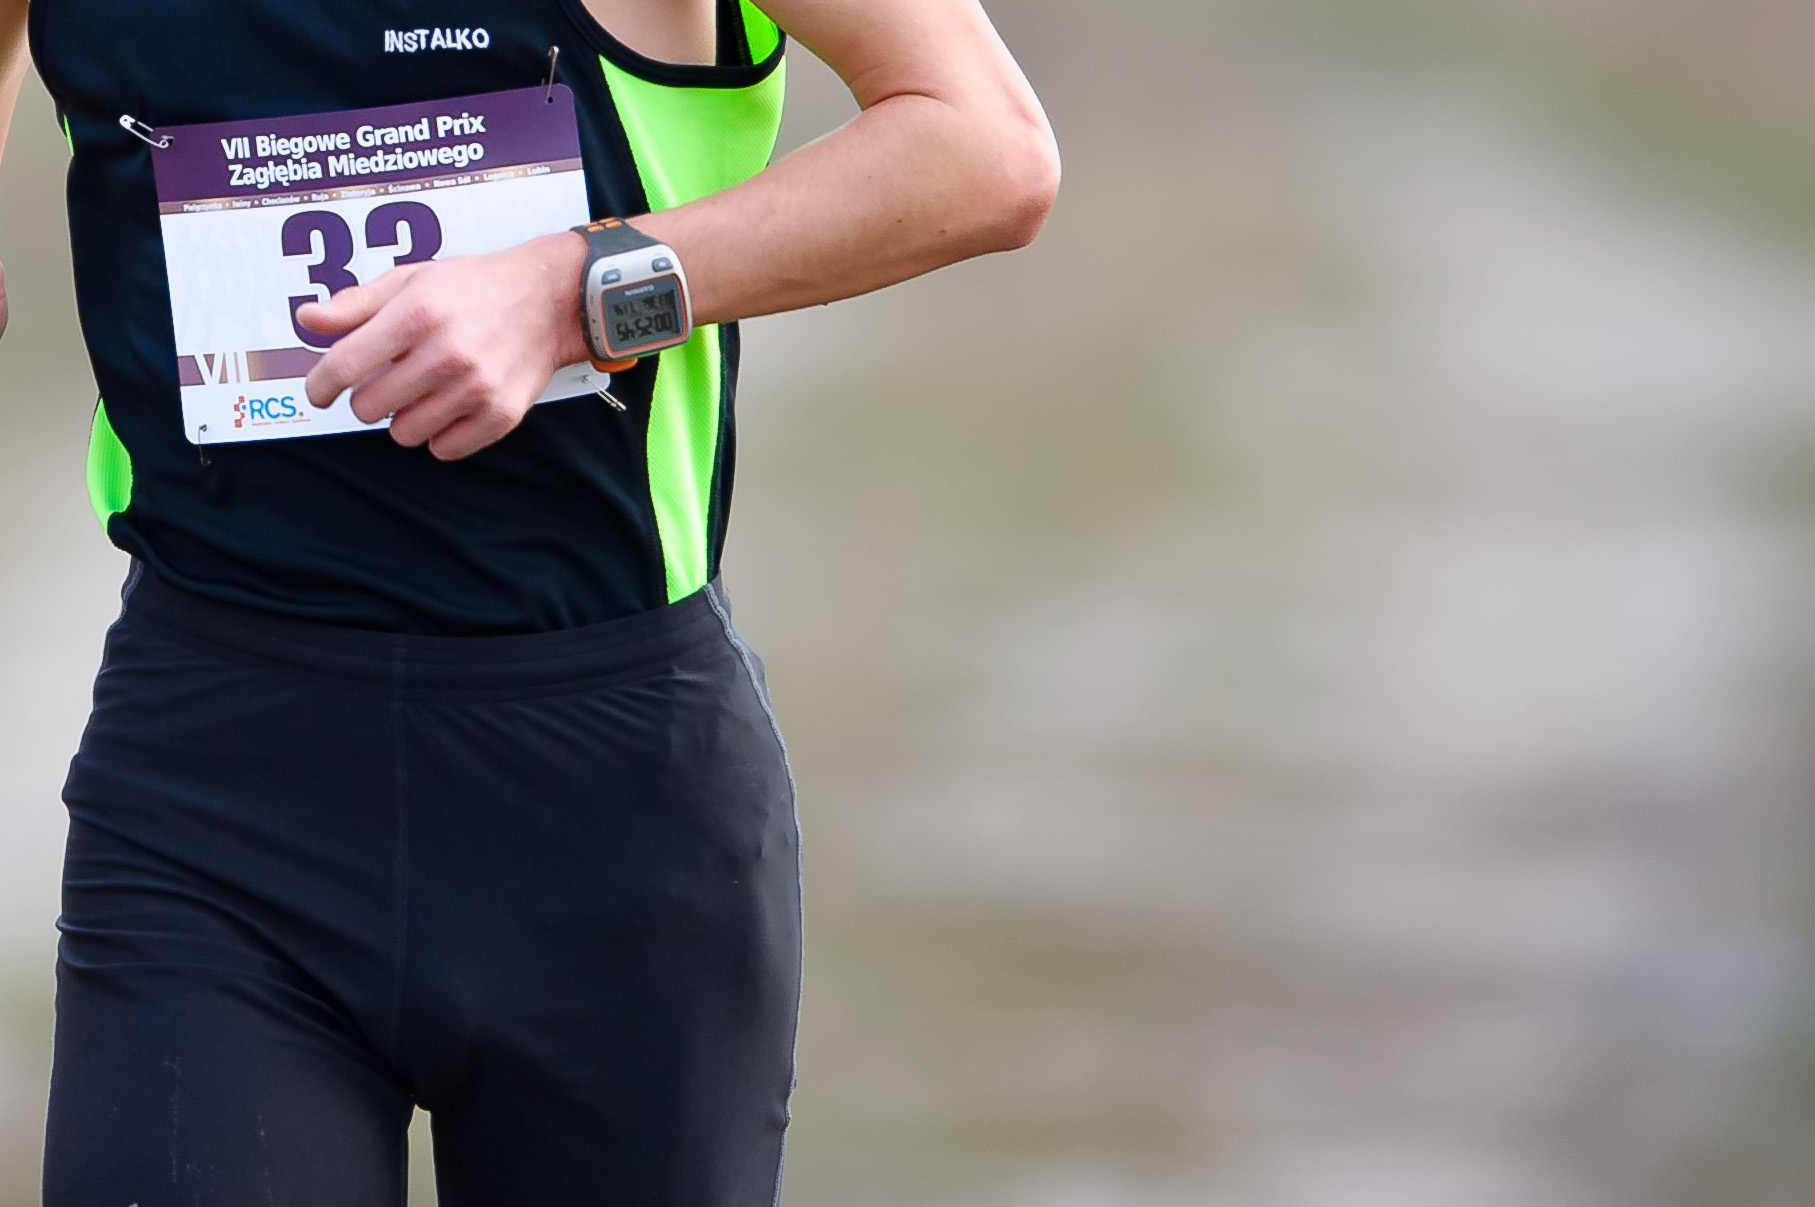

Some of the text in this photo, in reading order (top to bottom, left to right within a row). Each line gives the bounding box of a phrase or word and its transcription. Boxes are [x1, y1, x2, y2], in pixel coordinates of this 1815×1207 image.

[384, 27, 490, 53] INSTALKO
[221, 112, 486, 160] VII Biegowe Grand Prix
[227, 142, 485, 189] Zagłębia Miedziowego
